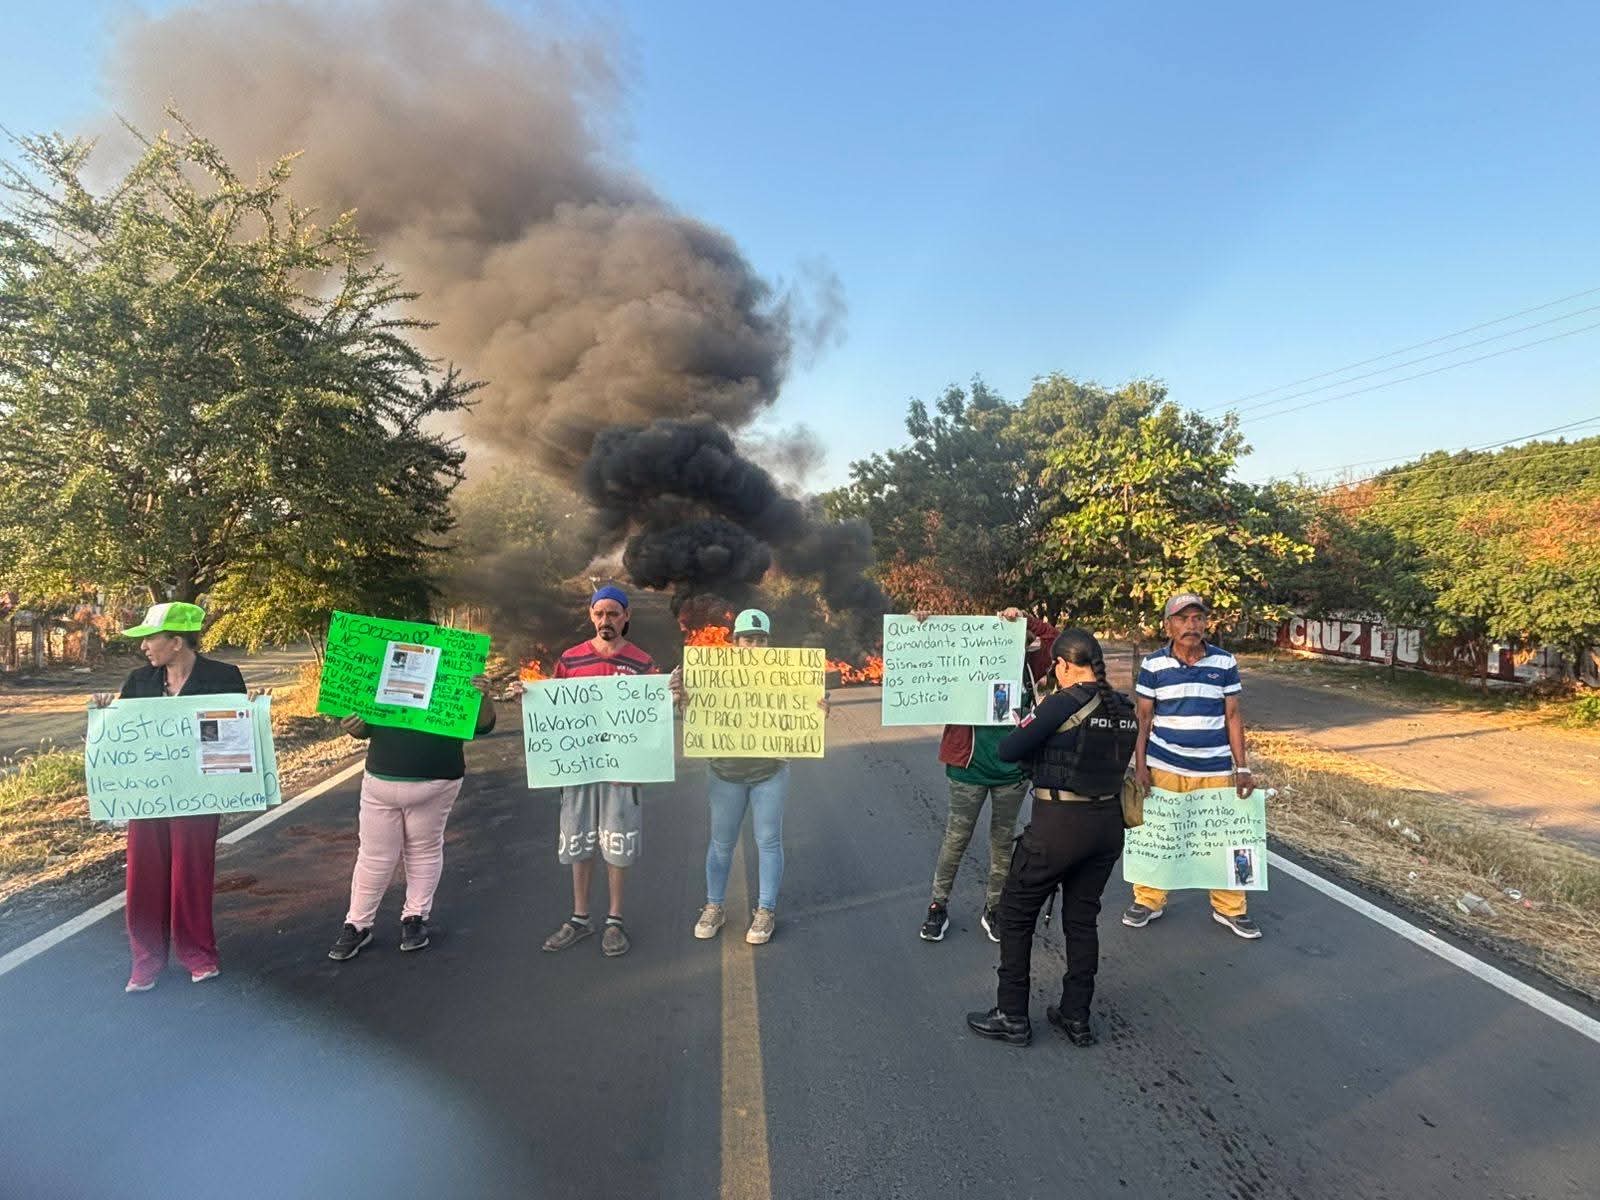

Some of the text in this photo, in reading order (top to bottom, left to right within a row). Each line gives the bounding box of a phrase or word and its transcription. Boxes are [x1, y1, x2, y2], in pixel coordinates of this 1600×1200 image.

[889, 622, 1004, 636] Queremos que el
[1289, 617, 1361, 654] CRUZ
[341, 632, 360, 647] NO
[763, 648, 795, 667] QUE
[980, 655, 1007, 666] nos
[885, 676, 904, 688] los
[724, 692, 741, 709] LA
[792, 694, 809, 710] SE
[1090, 718, 1138, 729] POLCIA
[527, 737, 552, 752] los
[549, 753, 620, 776] Justicia
